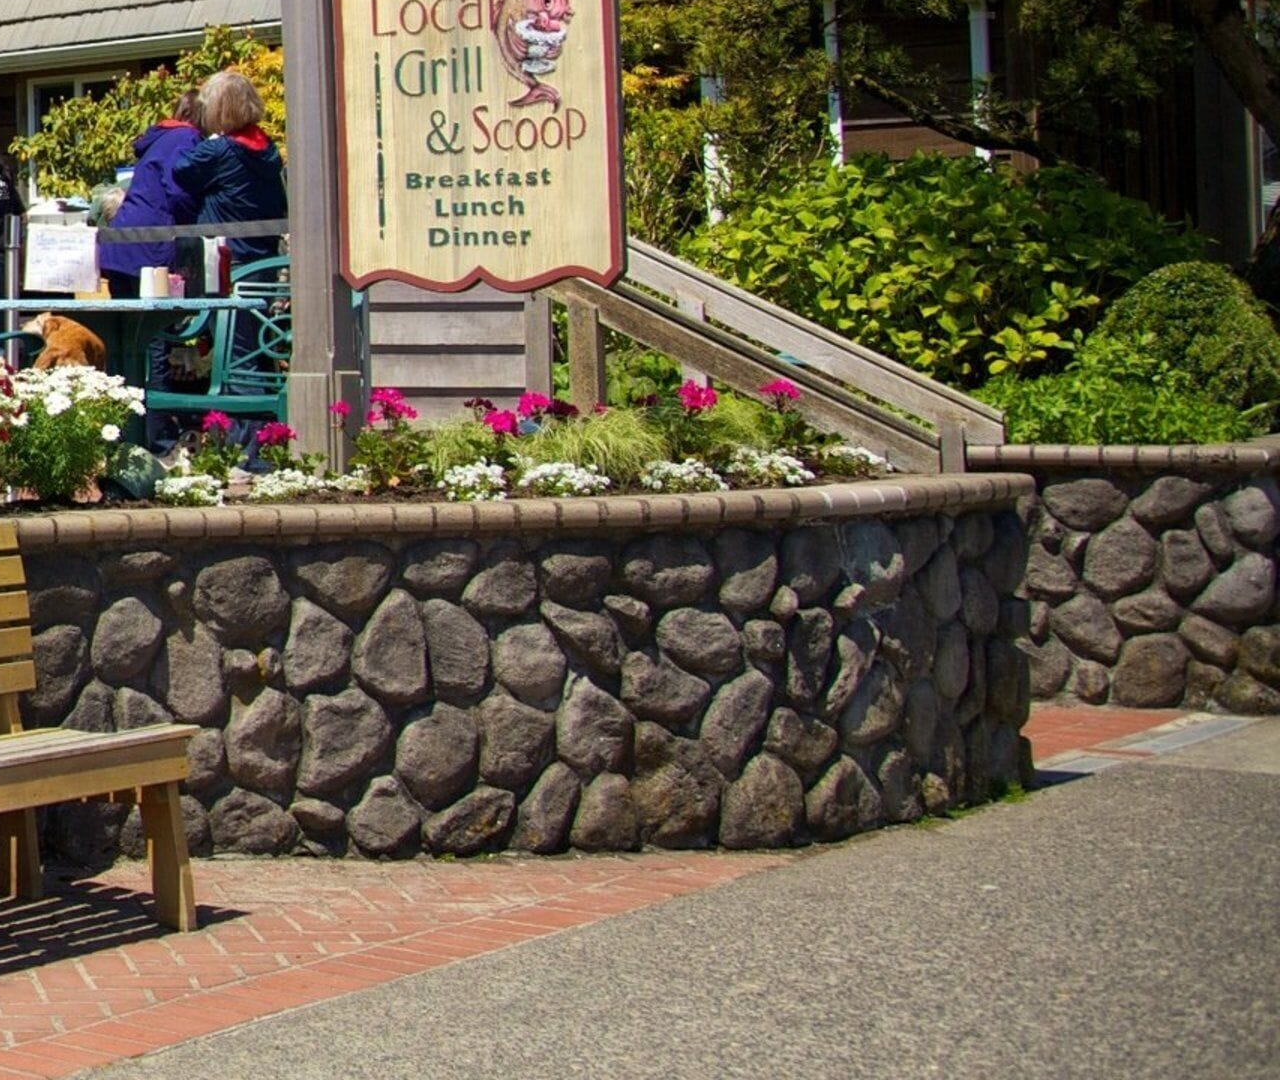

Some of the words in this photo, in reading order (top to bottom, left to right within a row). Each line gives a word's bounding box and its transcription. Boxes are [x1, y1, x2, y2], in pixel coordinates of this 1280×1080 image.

[394, 46, 483, 97] Grill
[426, 110, 464, 155] &
[472, 105, 587, 154] Scoop
[405, 168, 552, 190] Breakfast
[435, 196, 525, 218] Lunch
[428, 227, 532, 248] Dinner
